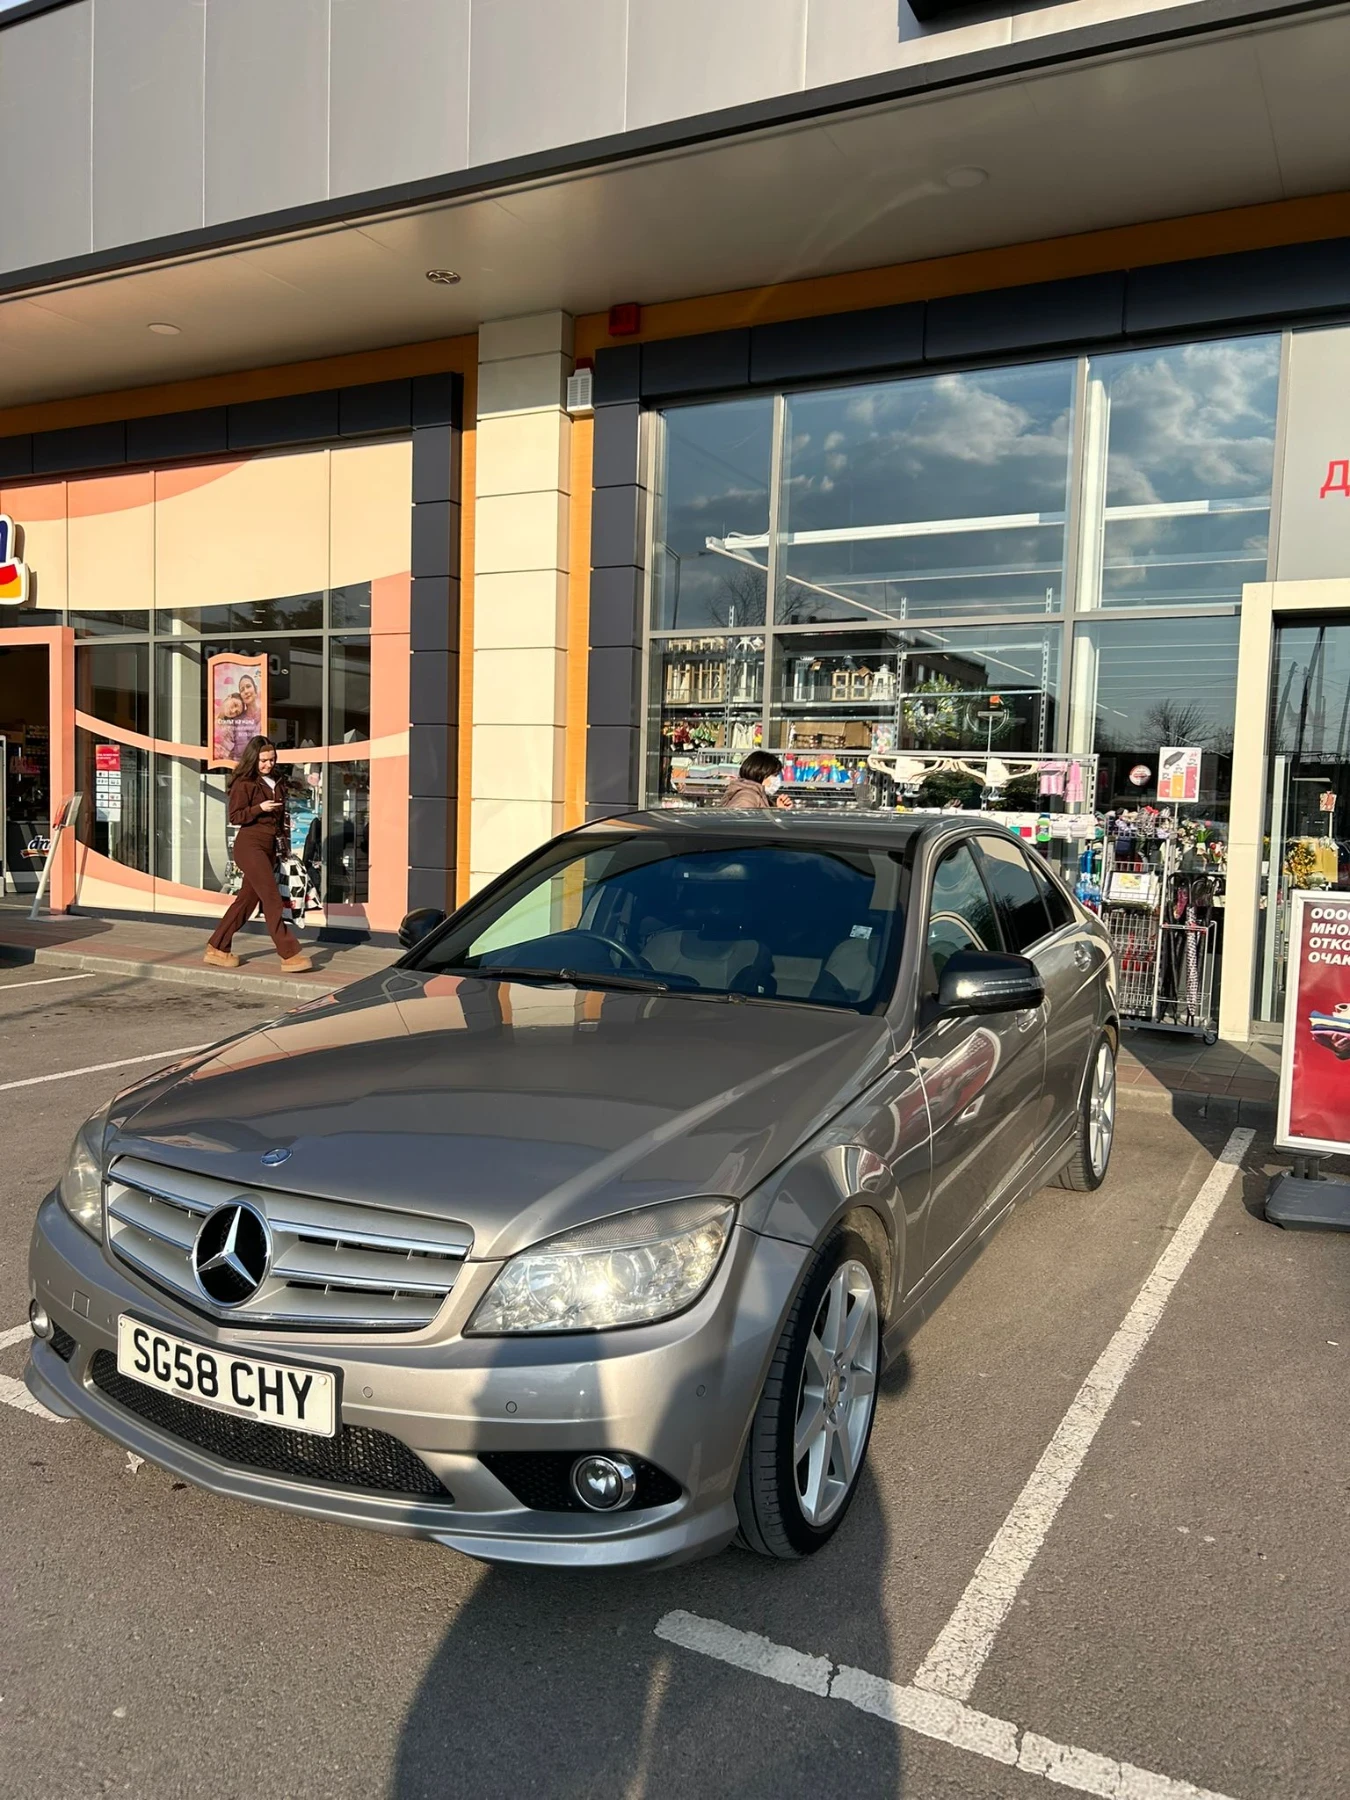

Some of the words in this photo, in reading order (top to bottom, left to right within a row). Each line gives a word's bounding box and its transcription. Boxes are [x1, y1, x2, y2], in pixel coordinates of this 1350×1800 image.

[1310, 907, 1350, 921] ООО
[1310, 922, 1350, 936] МНО
[133, 1328, 218, 1398] SG58
[230, 1361, 313, 1420] CHY
